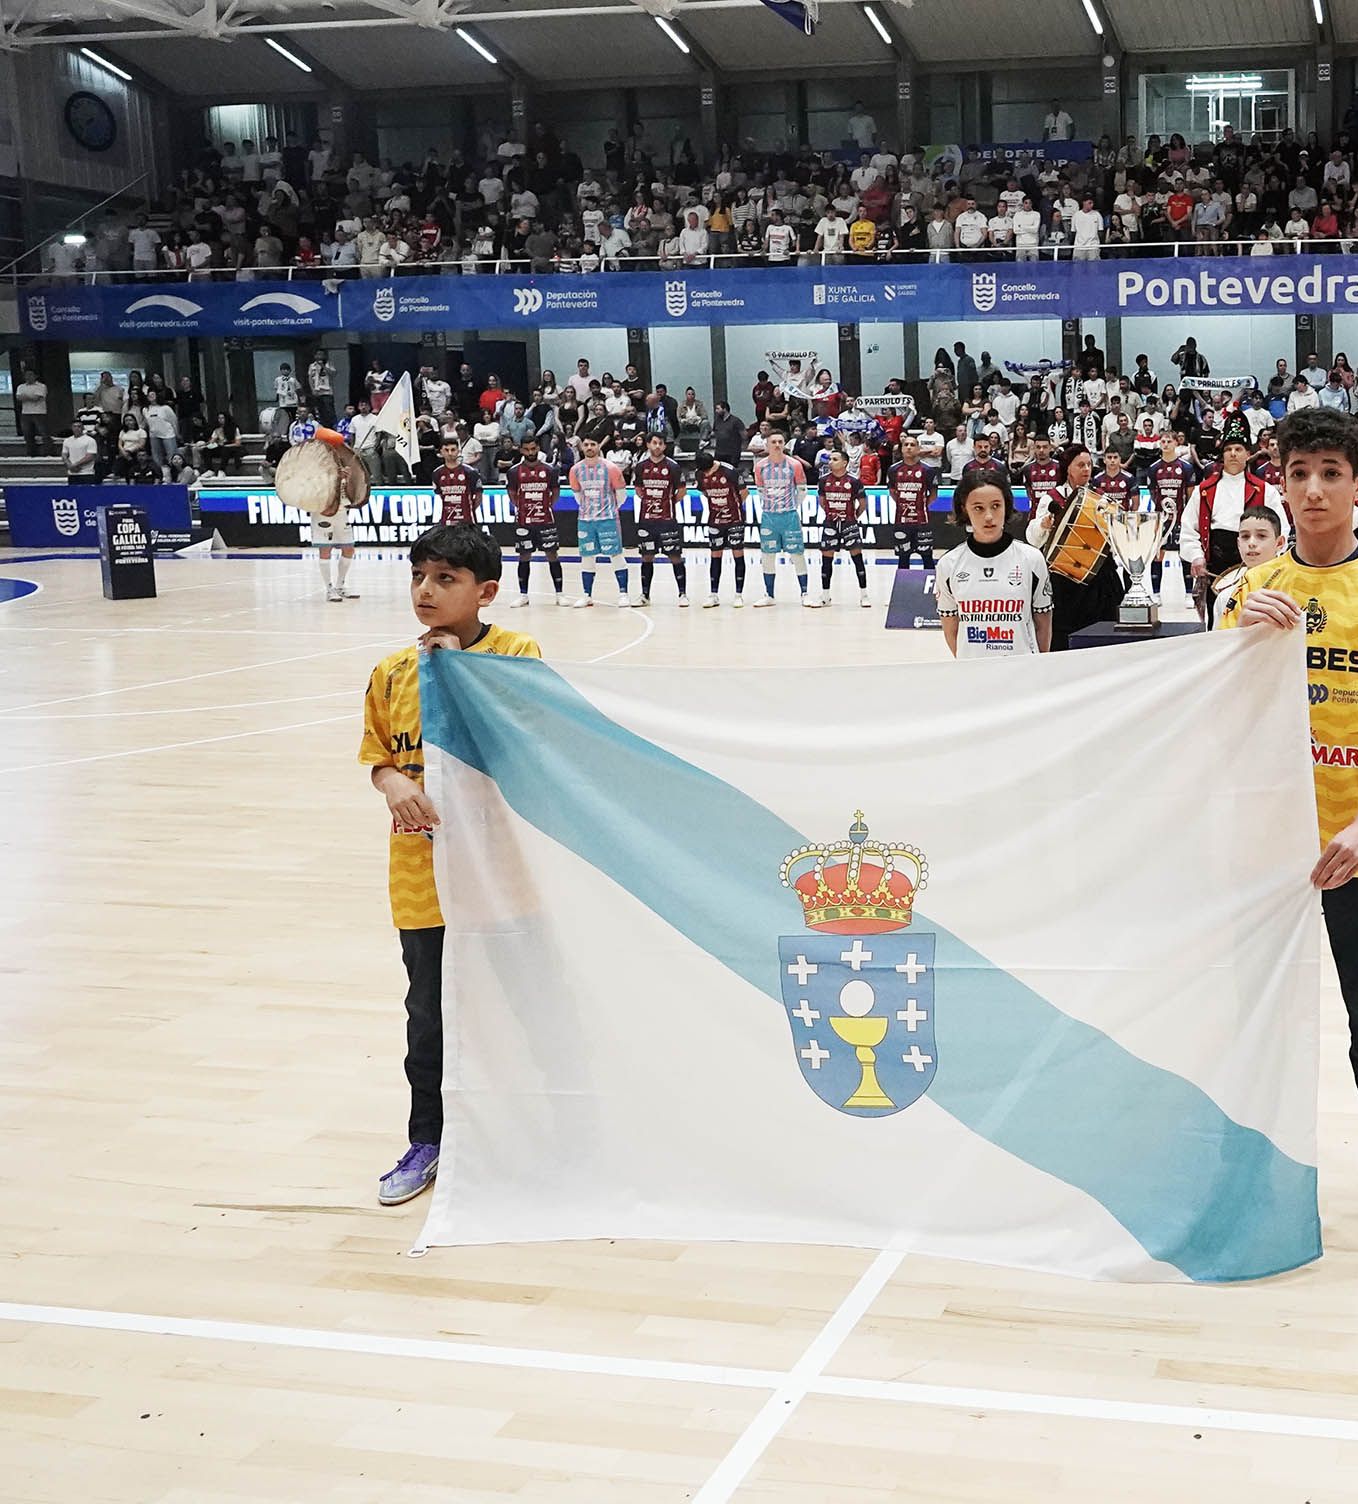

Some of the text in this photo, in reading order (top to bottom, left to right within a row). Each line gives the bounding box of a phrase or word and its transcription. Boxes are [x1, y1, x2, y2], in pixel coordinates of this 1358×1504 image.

[828, 286, 858, 294] XUNTA
[1002, 283, 1036, 292] Concello
[546, 290, 598, 302] Deputación
[691, 290, 722, 298] Concello
[842, 294, 876, 303] GALICIA
[1002, 291, 1060, 302] de Pontevedra
[546, 300, 598, 309] Pontevedra
[702, 298, 745, 307] Pontevedra
[411, 304, 450, 312] Pontevedra
[119, 318, 198, 329] visit-pontevedra.com
[233, 316, 313, 328] visit-pontevedra.com
[864, 397, 900, 407] PARRULO
[117, 523, 141, 533] COPA
[379, 526, 398, 542] DE
[112, 534, 147, 546] GALICIA
[967, 626, 1014, 642] BigMat
